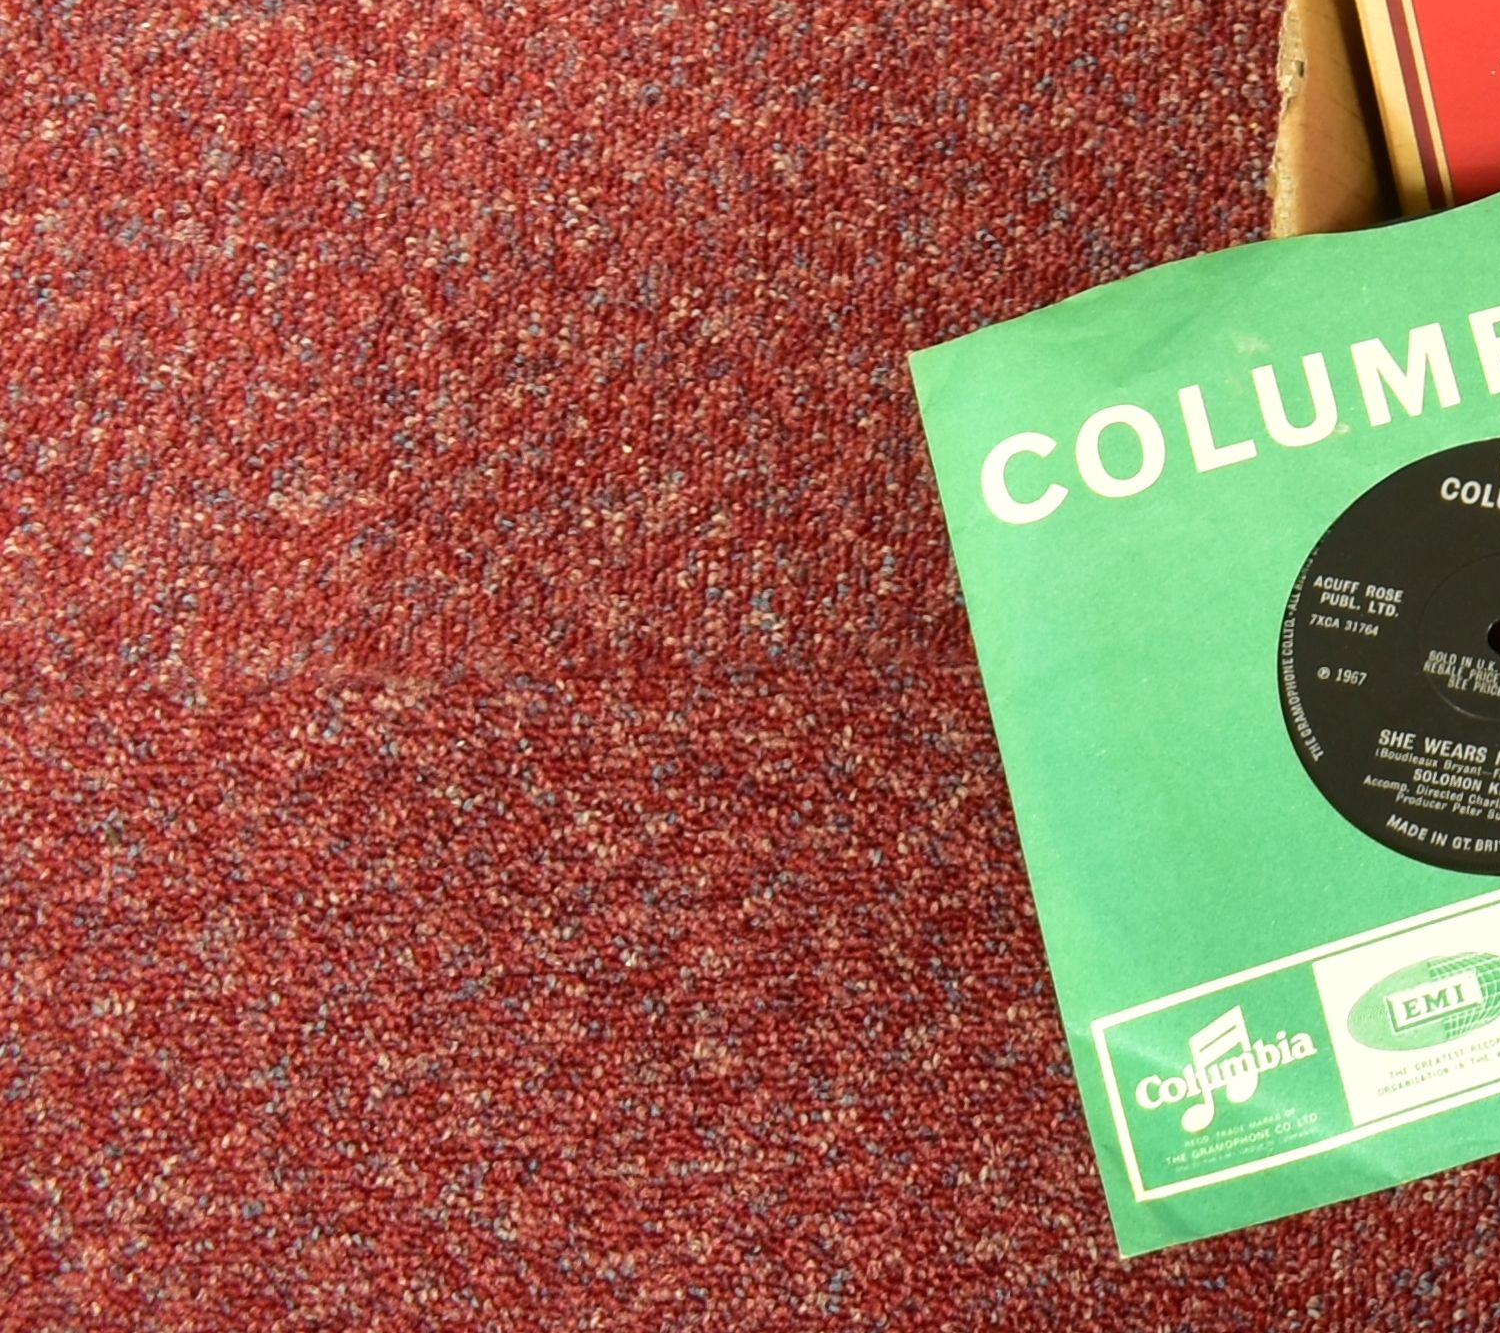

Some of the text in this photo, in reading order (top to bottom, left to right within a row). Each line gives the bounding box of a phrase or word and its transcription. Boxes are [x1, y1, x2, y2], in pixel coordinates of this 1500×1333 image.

[1313, 575, 1404, 603] ACUFF ROSE
[1320, 591, 1400, 618] PUBL. LTD.
[1308, 614, 1380, 637] 7XCA 31764
[1335, 667, 1368, 686] 1967
[1378, 729, 1416, 750] SHE
[1423, 736, 1488, 763] WEARS
[1363, 775, 1410, 793] Accomp.
[1416, 784, 1463, 802] Directed
[1413, 768, 1483, 792] SOLOMON
[1395, 791, 1448, 810] Producer
[1452, 803, 1483, 817] Peter
[1385, 814, 1428, 841] MADE
[1430, 831, 1448, 847] IN
[1452, 836, 1472, 851] GT.
[1402, 982, 1466, 1021] EMI
[1135, 1028, 1318, 1110] Columbia
